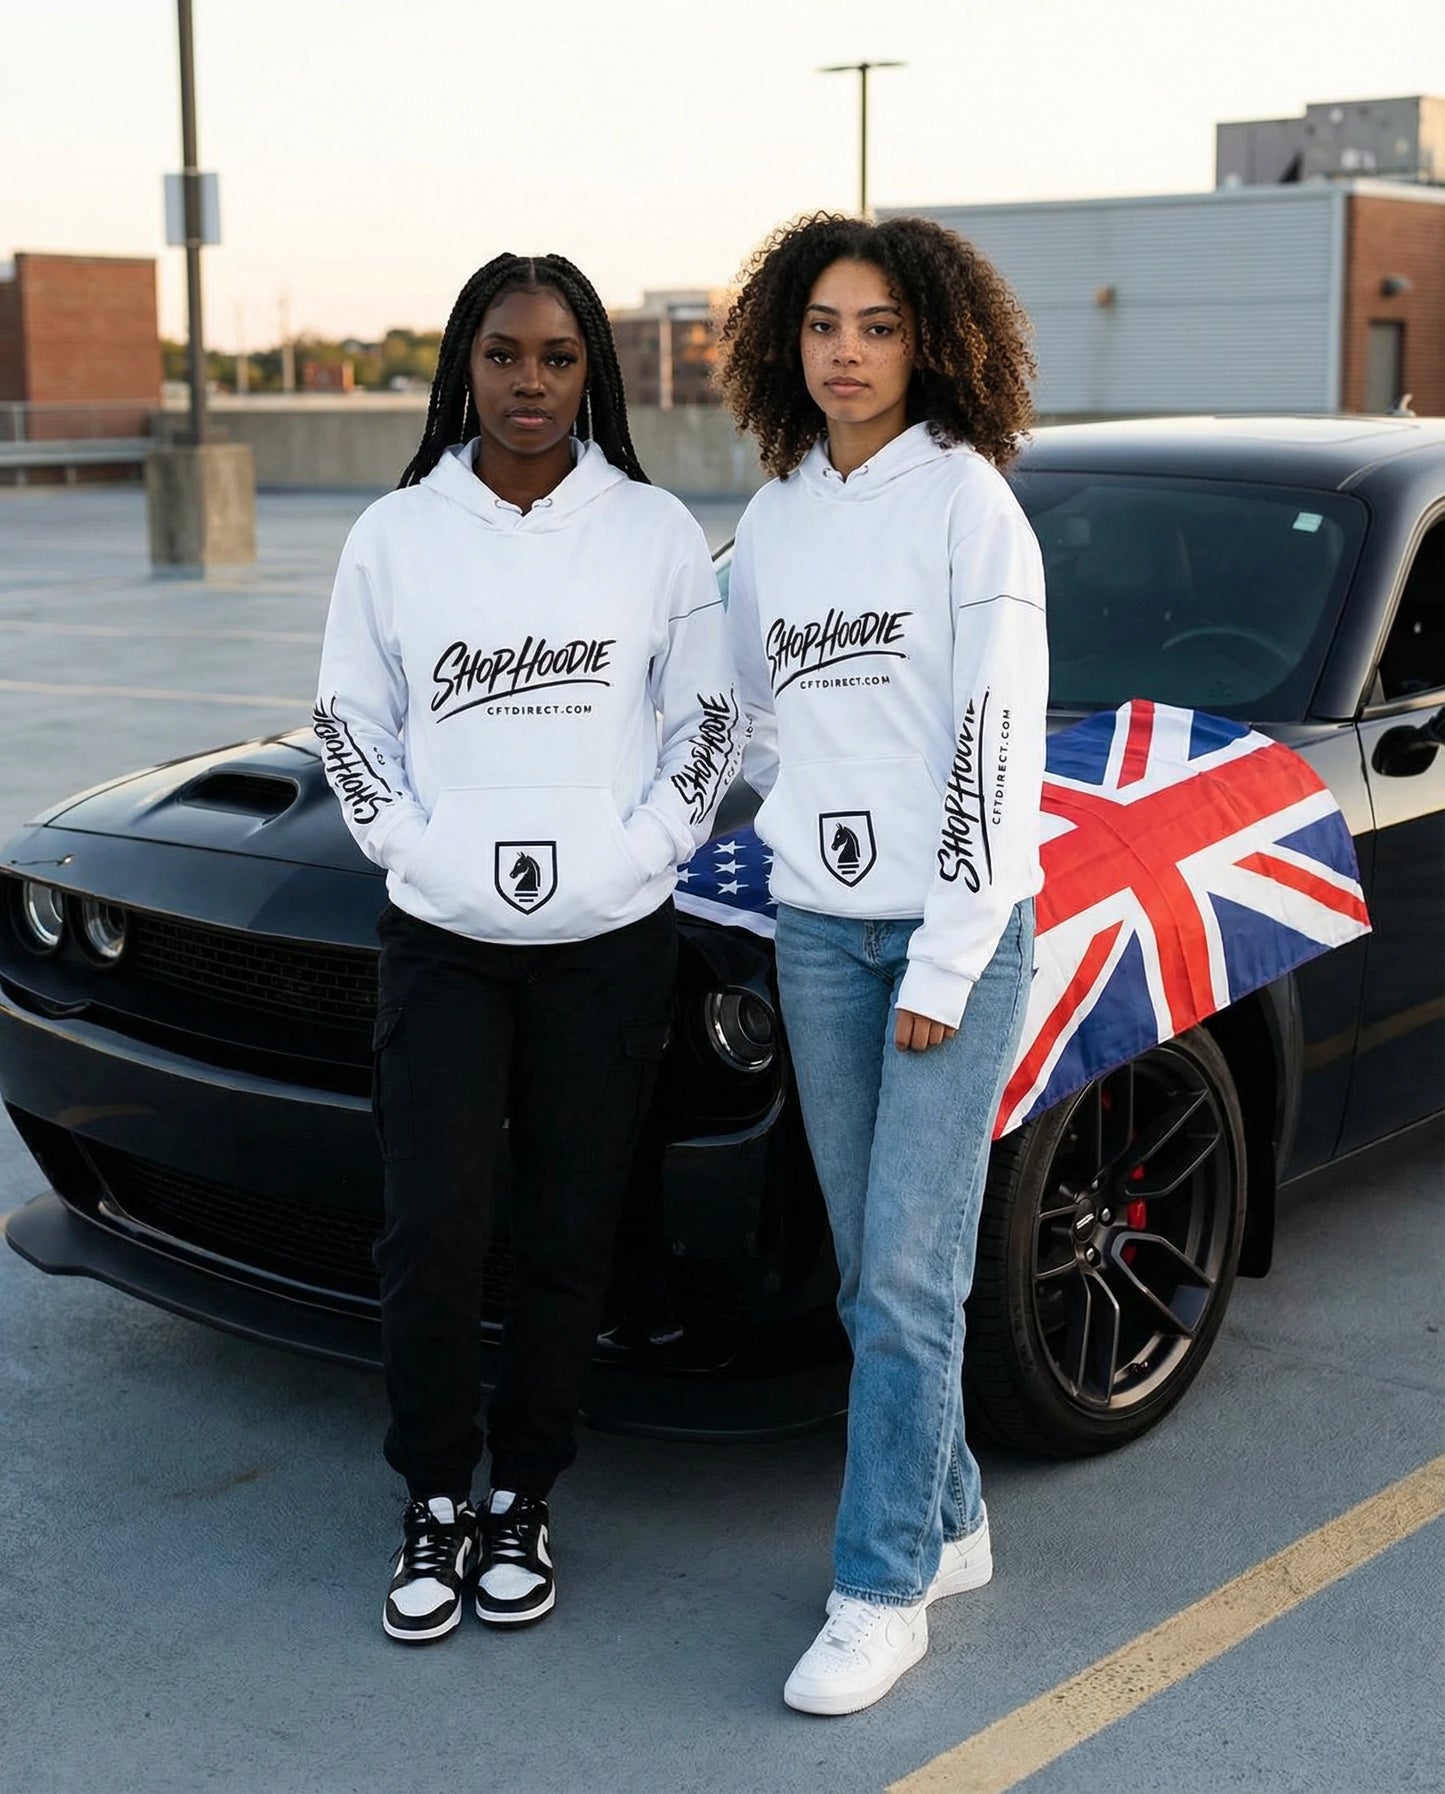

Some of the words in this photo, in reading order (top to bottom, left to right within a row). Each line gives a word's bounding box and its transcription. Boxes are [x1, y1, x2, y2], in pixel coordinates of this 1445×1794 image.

[431, 635, 617, 712] SHOPHOODIE
[800, 676, 890, 690] CFTDIRECT.COM
[487, 705, 592, 716] CFTDIRECT.COM
[992, 709, 1011, 825] CFTDIRECT.COM
